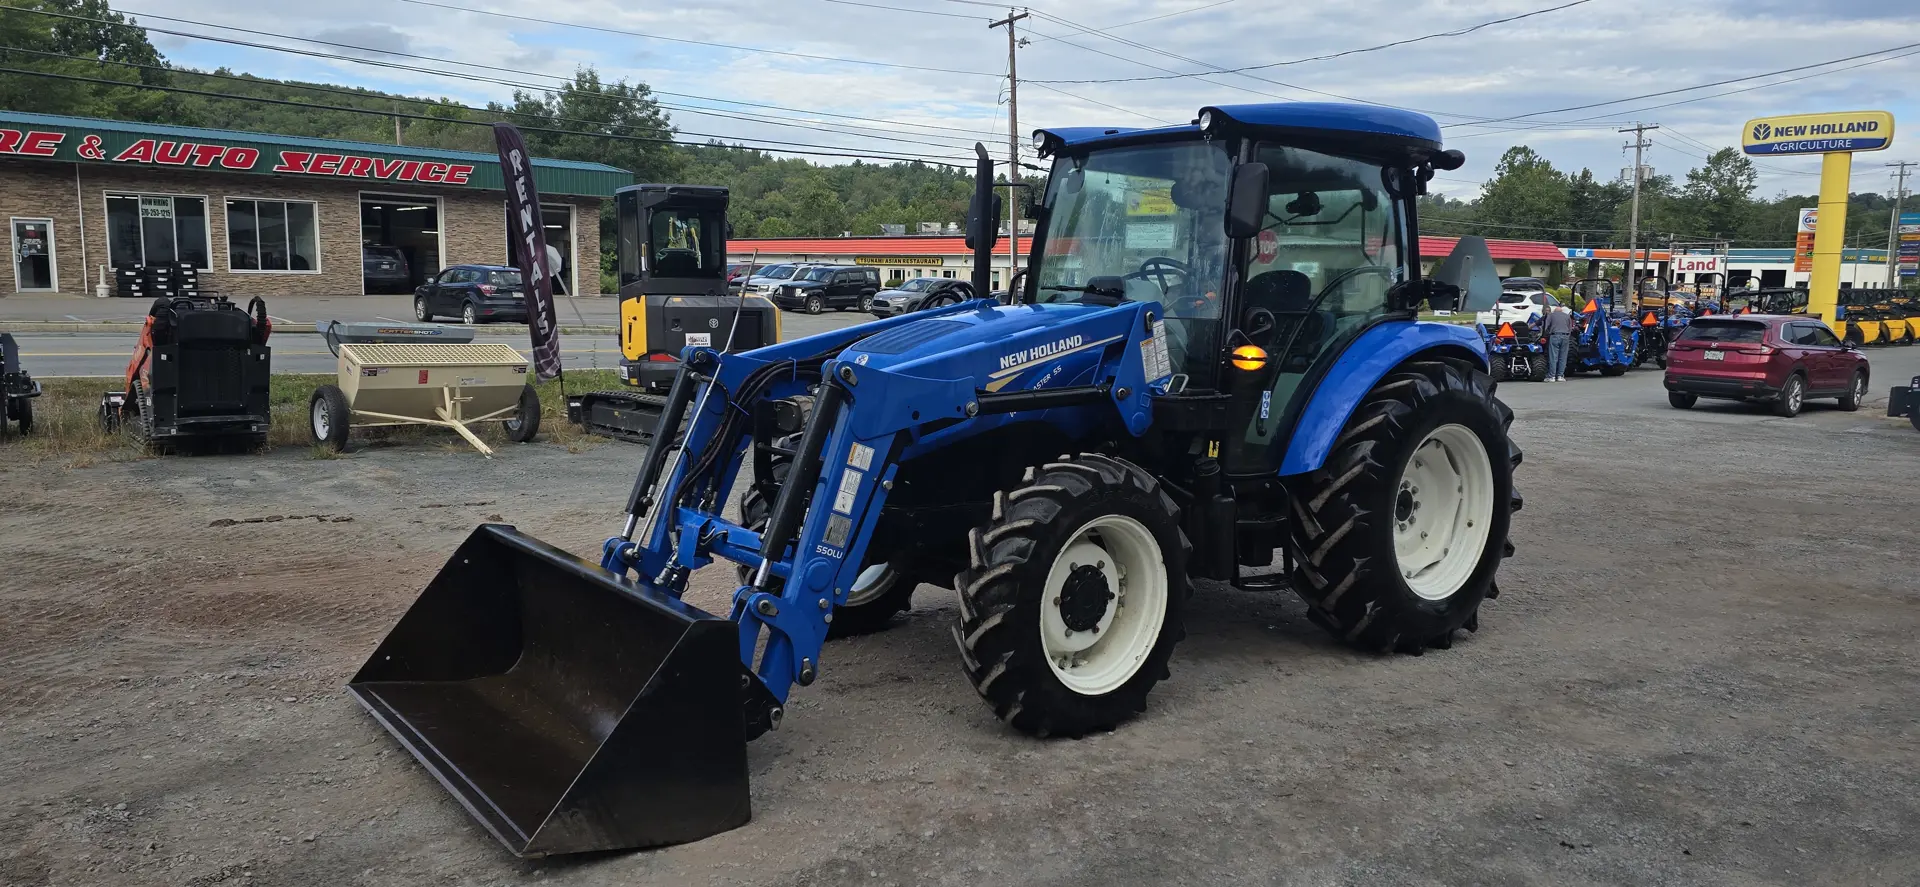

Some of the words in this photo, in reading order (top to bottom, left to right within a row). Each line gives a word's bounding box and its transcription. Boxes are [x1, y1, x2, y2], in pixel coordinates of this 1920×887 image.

[1774, 125, 1807, 137] NEW
[1810, 121, 1878, 135] HOLLAND
[1771, 139, 1852, 152] AGRICULTURE
[77, 134, 107, 160] &
[112, 139, 260, 169] AUTO
[273, 151, 475, 184] SERVICE
[1804, 216, 1818, 224] Gu
[509, 148, 549, 336] RENTALS
[1677, 257, 1717, 271] Land
[1000, 350, 1028, 369] NEW
[1030, 334, 1083, 361] HOLLAND
[1033, 373, 1051, 390] ASTER
[1053, 365, 1062, 376] 55
[816, 545, 843, 559] 550LU
